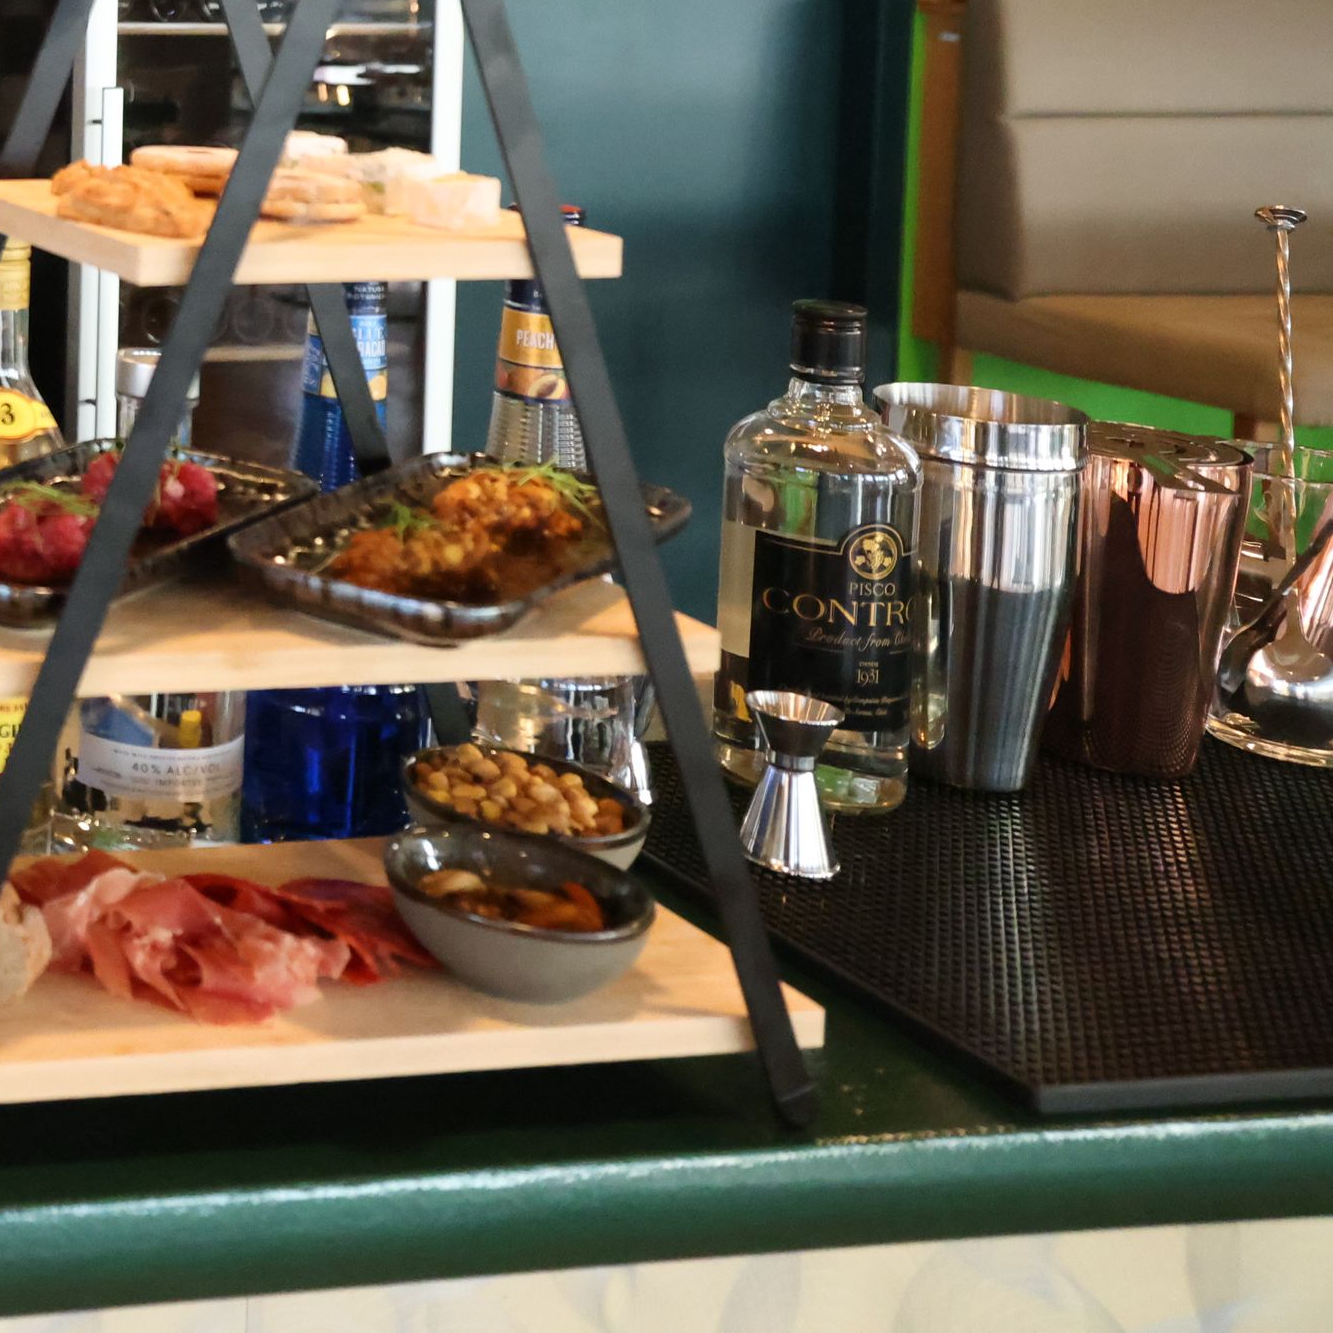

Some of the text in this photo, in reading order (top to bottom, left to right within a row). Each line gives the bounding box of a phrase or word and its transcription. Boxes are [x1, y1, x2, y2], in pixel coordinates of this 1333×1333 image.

[516, 329, 555, 351] PEACH
[1, 402, 15, 426] 3
[849, 582, 896, 597] PISCO
[805, 628, 861, 648] Product
[858, 631, 890, 652] from
[856, 669, 880, 687] 1931
[131, 762, 161, 775] 40%
